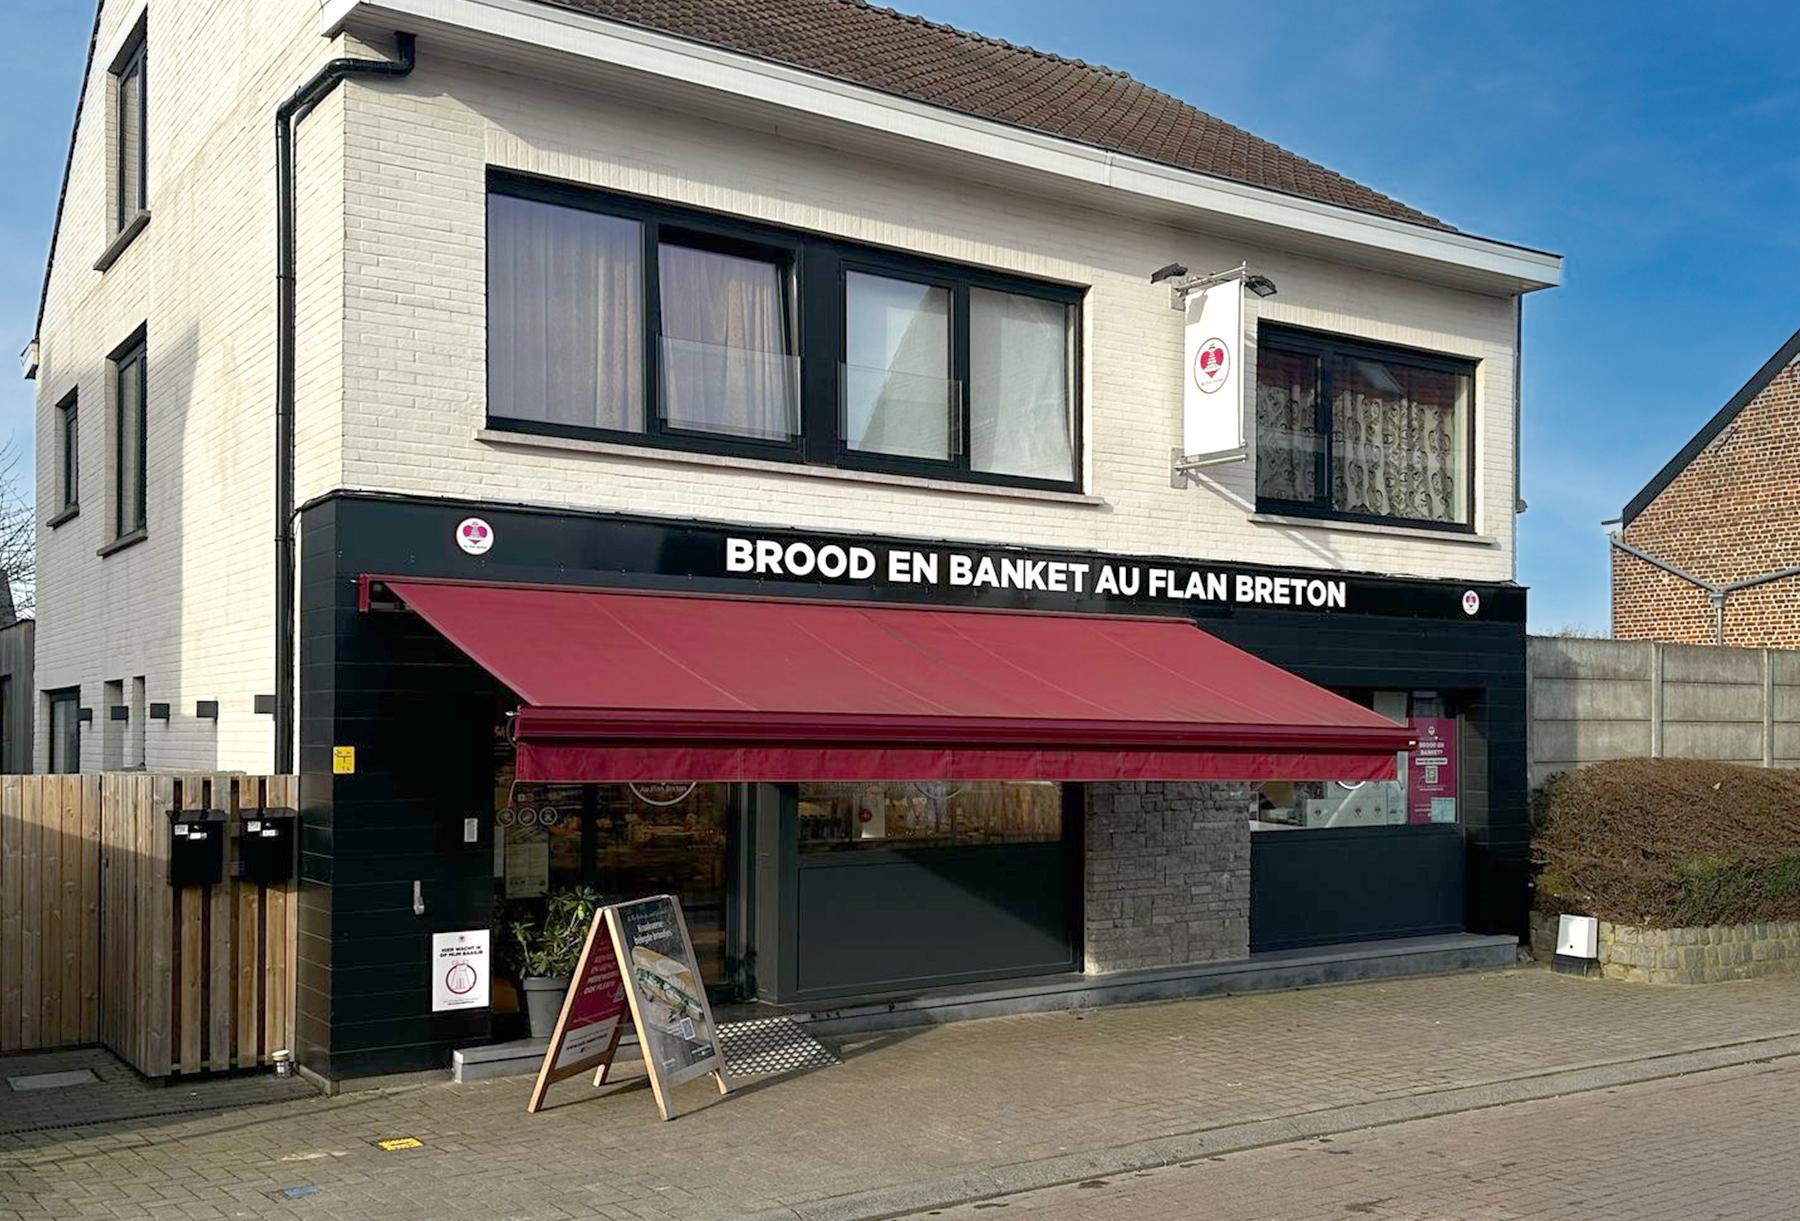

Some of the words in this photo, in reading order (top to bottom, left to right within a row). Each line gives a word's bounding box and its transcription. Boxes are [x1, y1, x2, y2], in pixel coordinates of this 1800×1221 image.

[726, 537, 876, 579] BROOD
[888, 550, 938, 584] EN
[950, 554, 1089, 593] BANKET
[1094, 564, 1140, 596] AU
[1149, 568, 1228, 601] FLAN
[1235, 575, 1346, 608] BRETON
